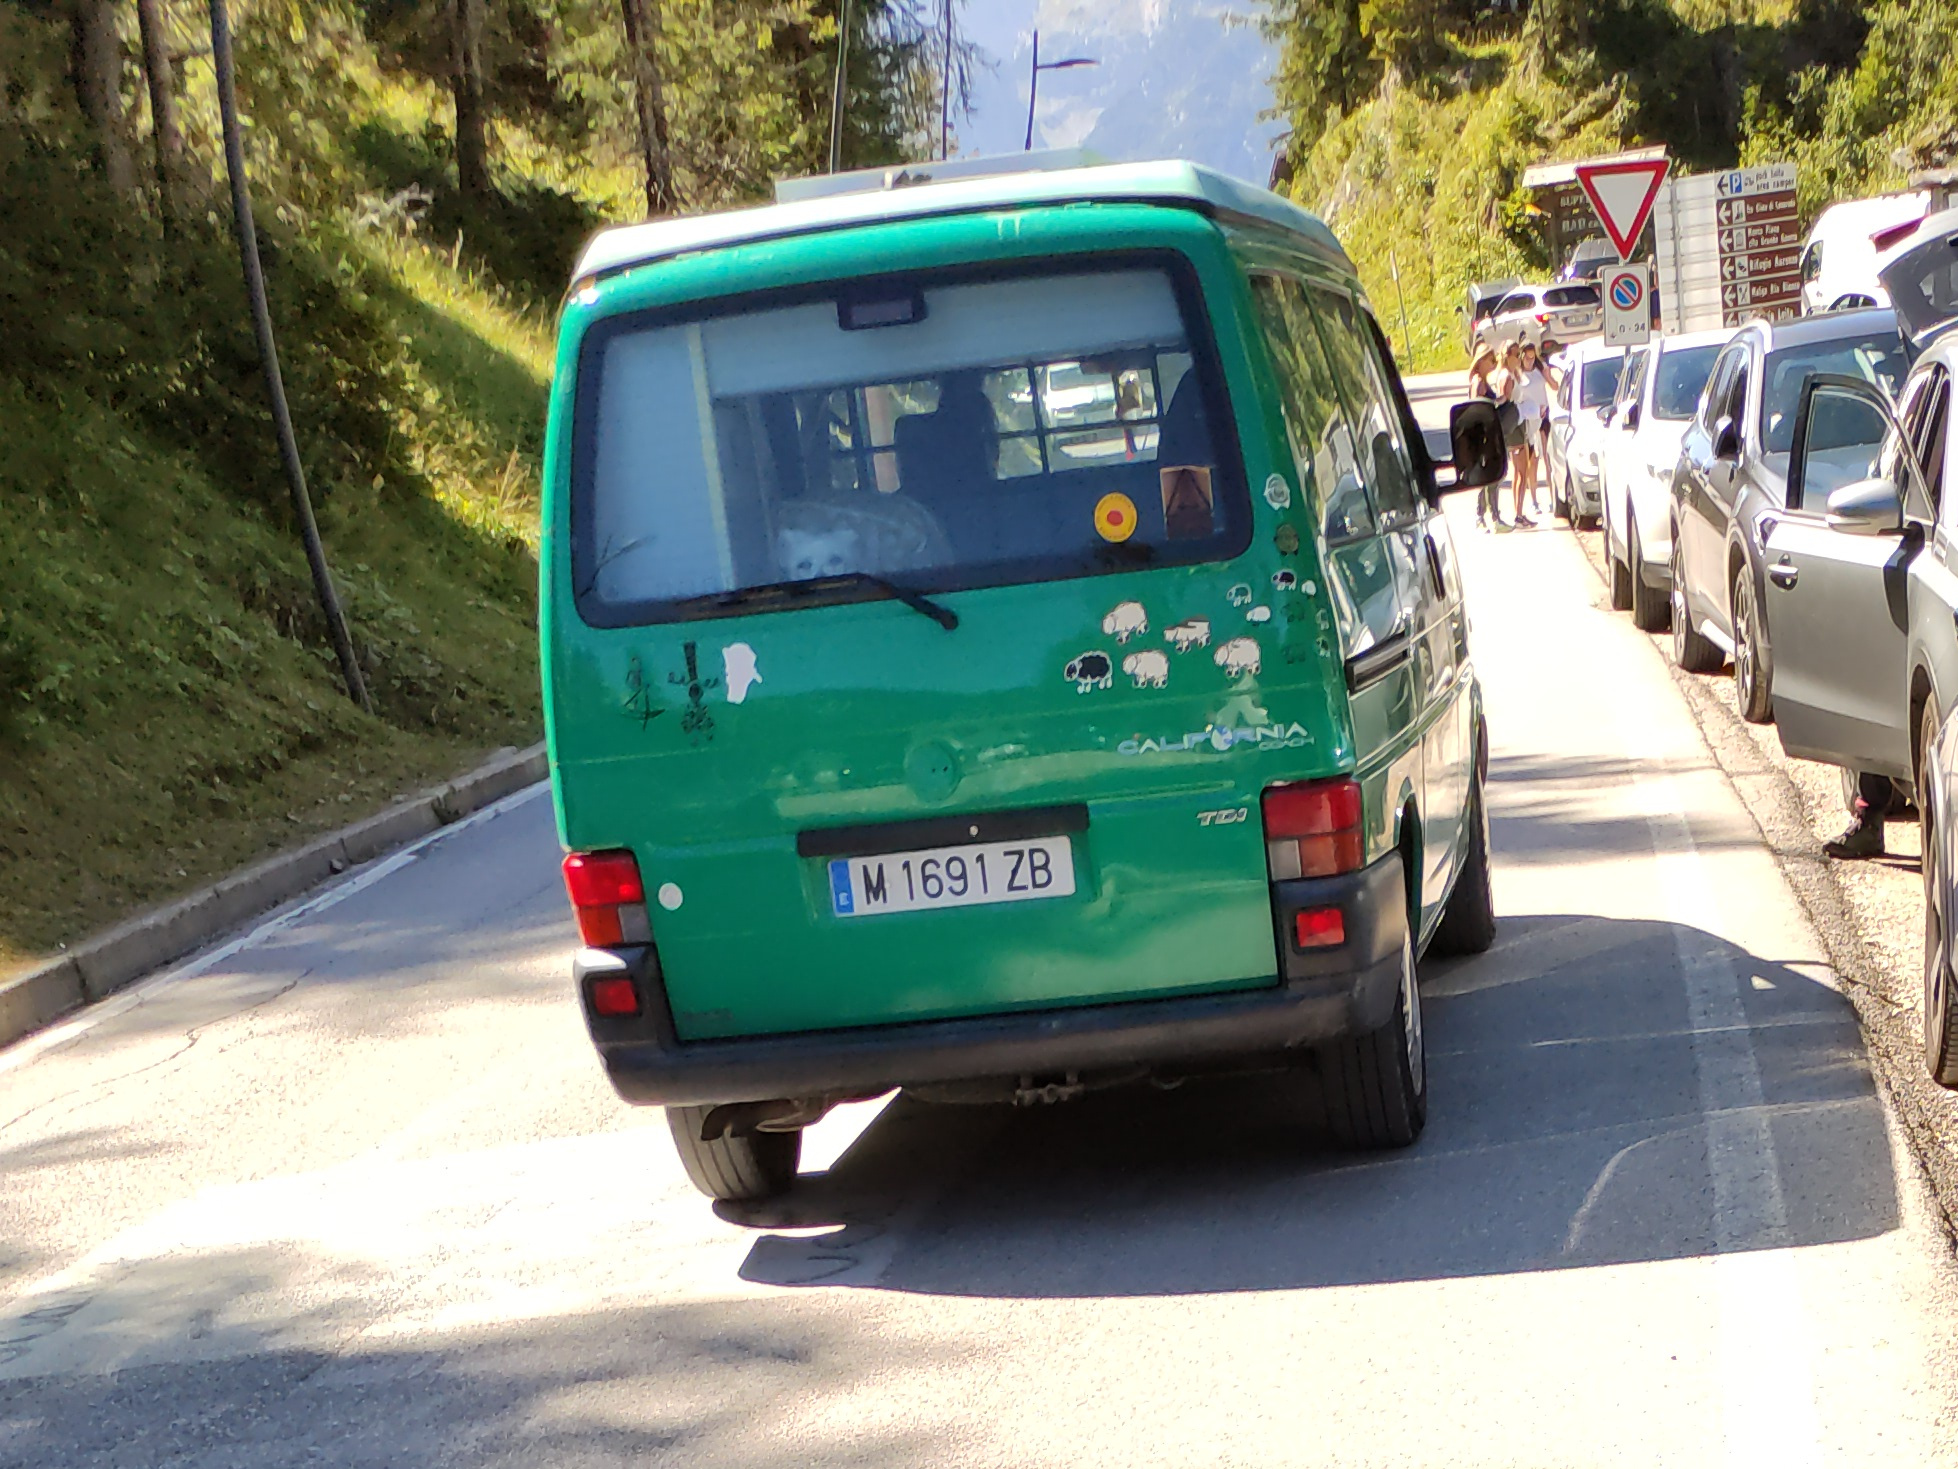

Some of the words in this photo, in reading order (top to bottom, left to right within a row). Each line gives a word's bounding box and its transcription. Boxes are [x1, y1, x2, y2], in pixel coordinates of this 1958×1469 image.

[1749, 257, 1772, 272] Rifugio
[1117, 722, 1308, 755] CALIFORNIA
[1196, 808, 1249, 827] TDI
[862, 861, 888, 905] M
[902, 853, 988, 901] 1691
[1003, 848, 1053, 892] ZB
